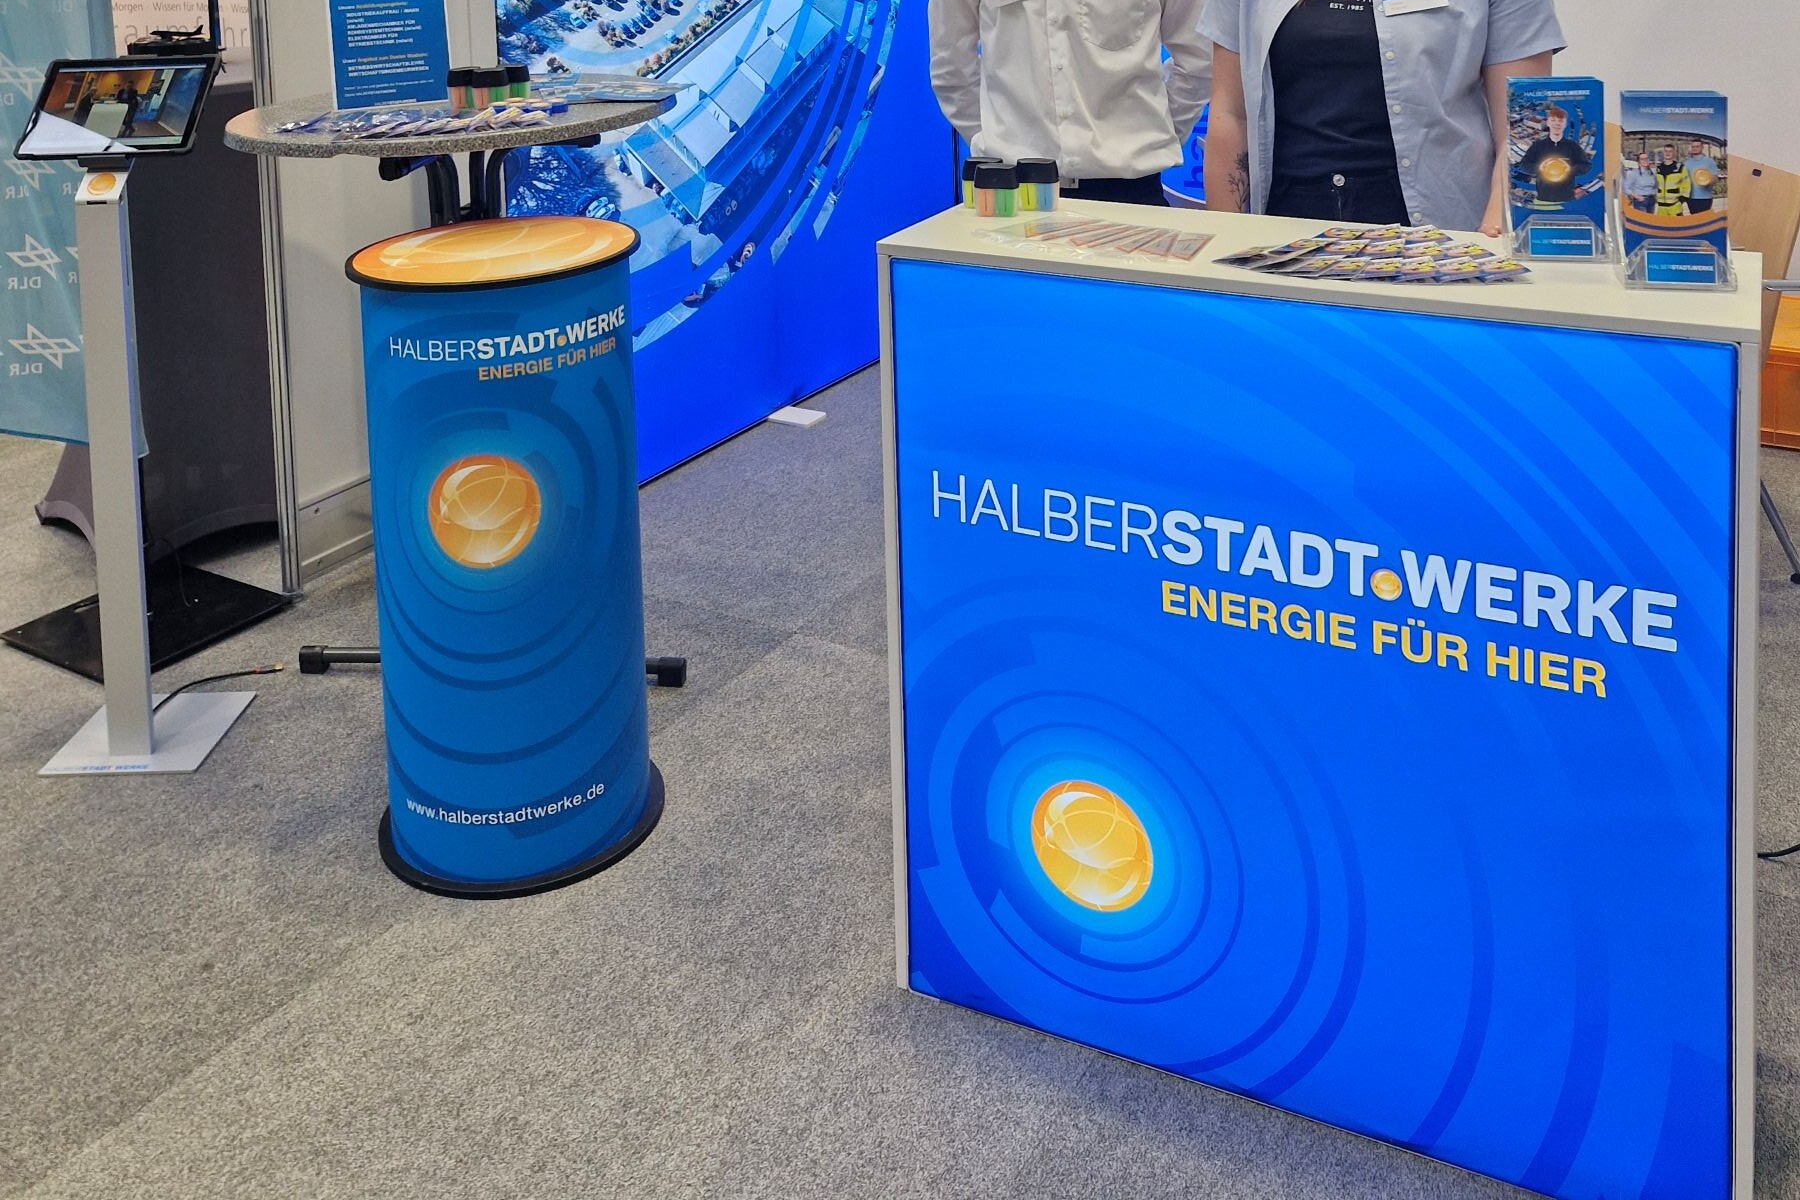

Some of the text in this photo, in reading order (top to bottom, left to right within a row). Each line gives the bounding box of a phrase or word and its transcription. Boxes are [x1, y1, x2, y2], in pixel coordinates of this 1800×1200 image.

[153, 1, 181, 11] Wissen
[183, 1, 194, 11] für
[478, 336, 617, 382] ENERGIE FÜR HIER
[1162, 579, 1608, 700] ENERGIE FÜR HIER
[406, 782, 605, 825] www.halberstadtwerke.de
